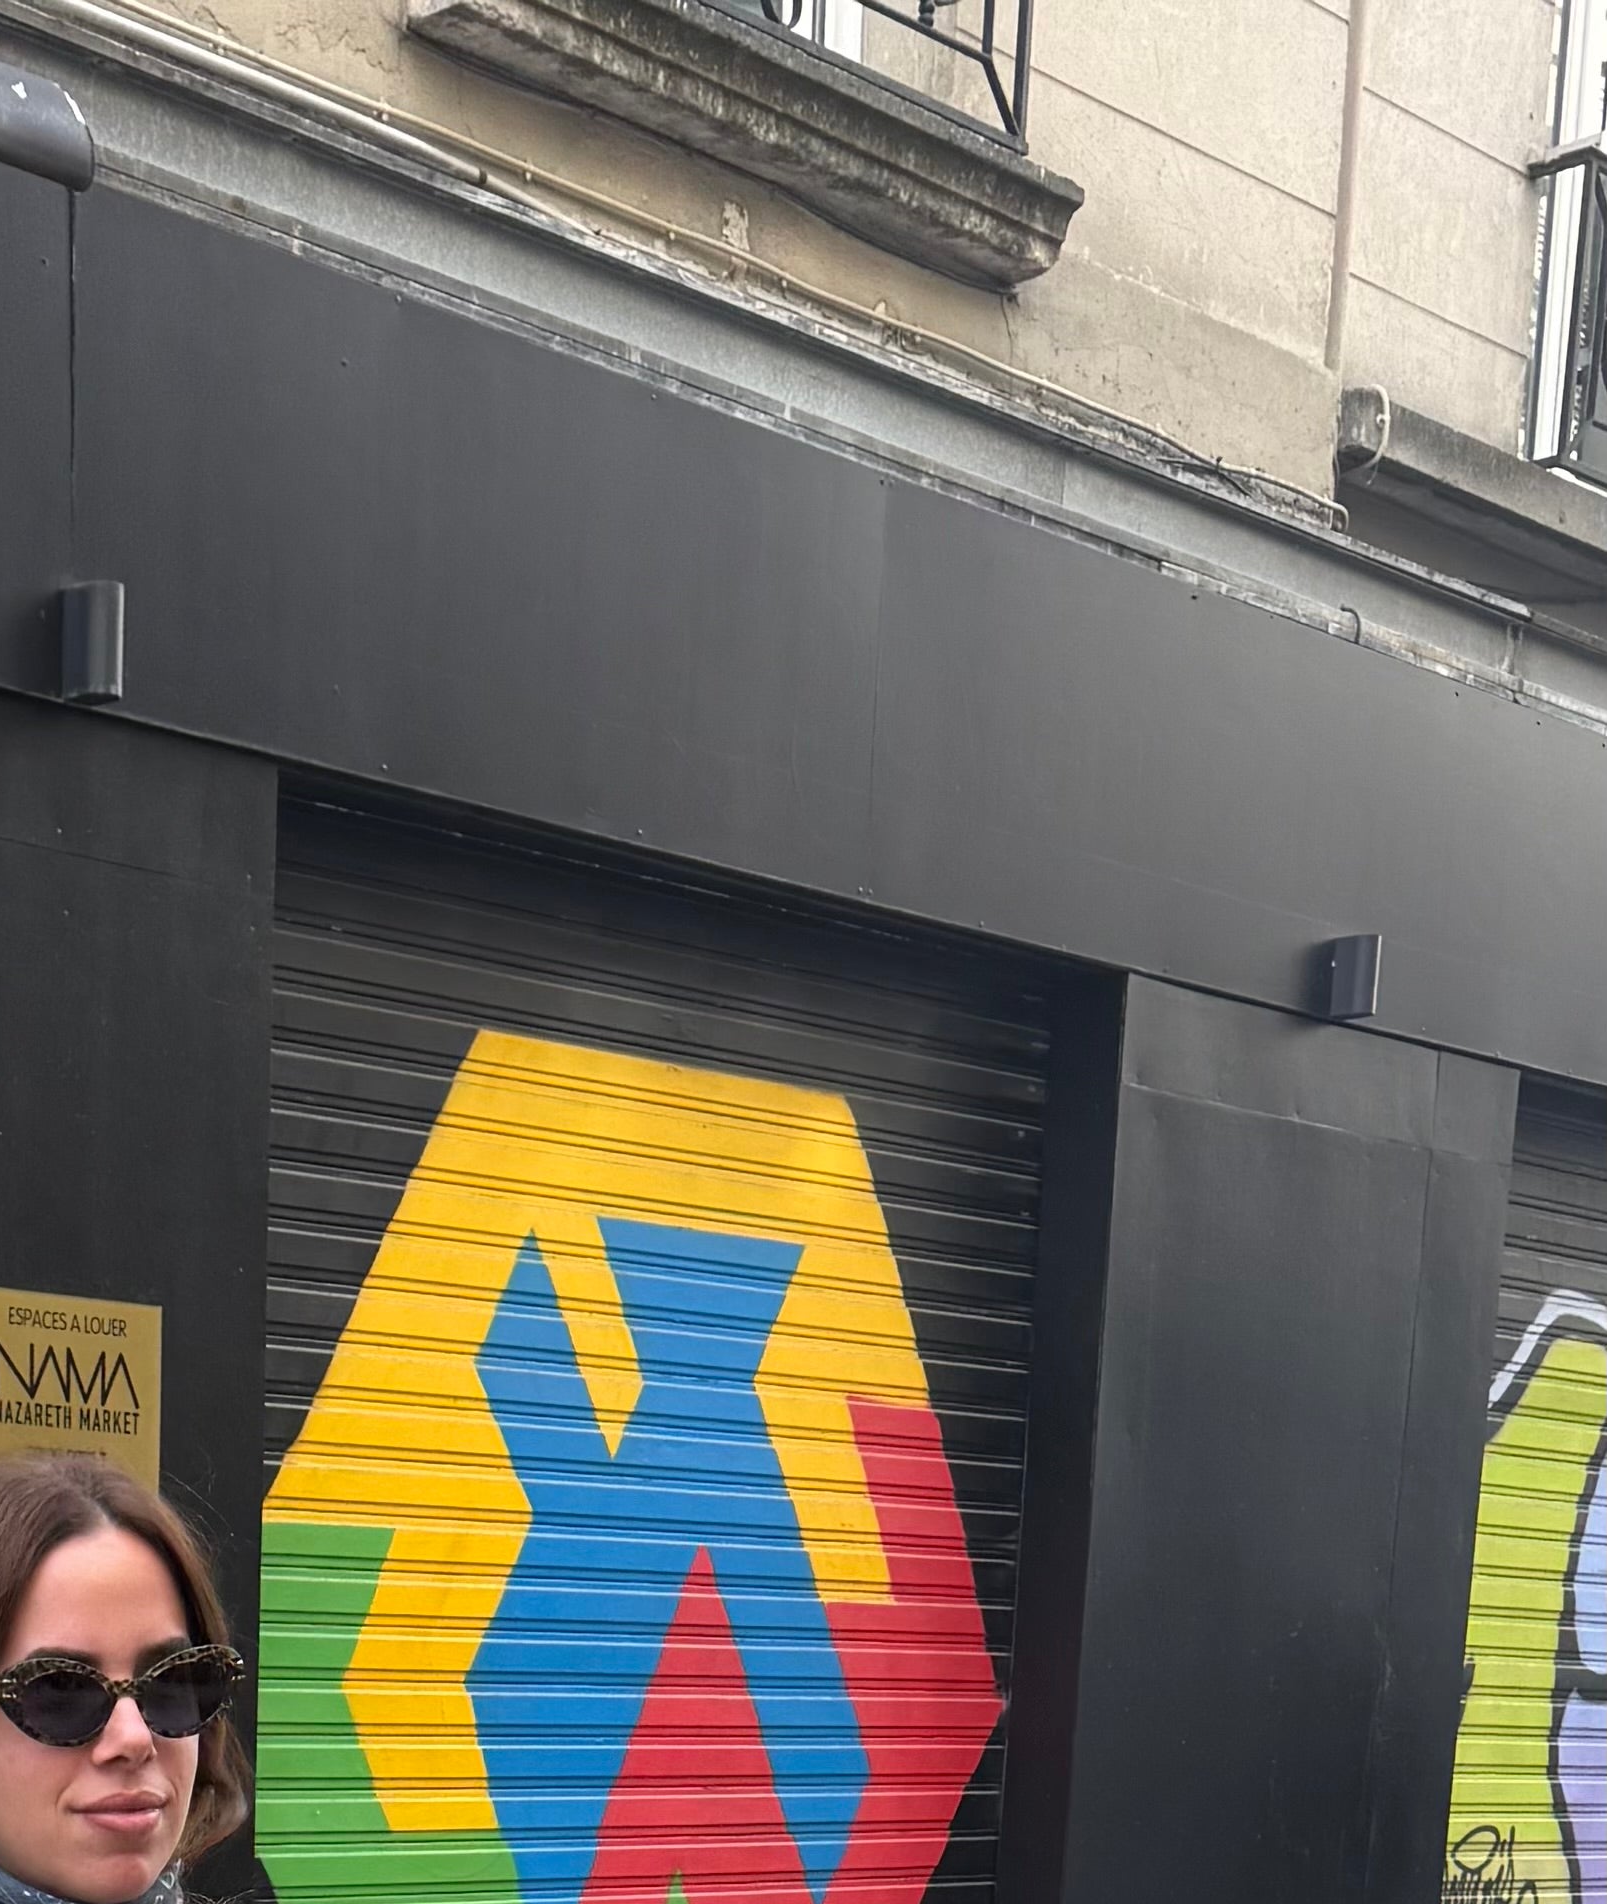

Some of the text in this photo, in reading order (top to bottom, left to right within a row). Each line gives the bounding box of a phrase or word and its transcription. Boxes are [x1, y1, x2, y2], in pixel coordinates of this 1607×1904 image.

[8, 1306, 127, 1338] ESPACES A LOUER
[79, 1407, 140, 1435] MARKET
